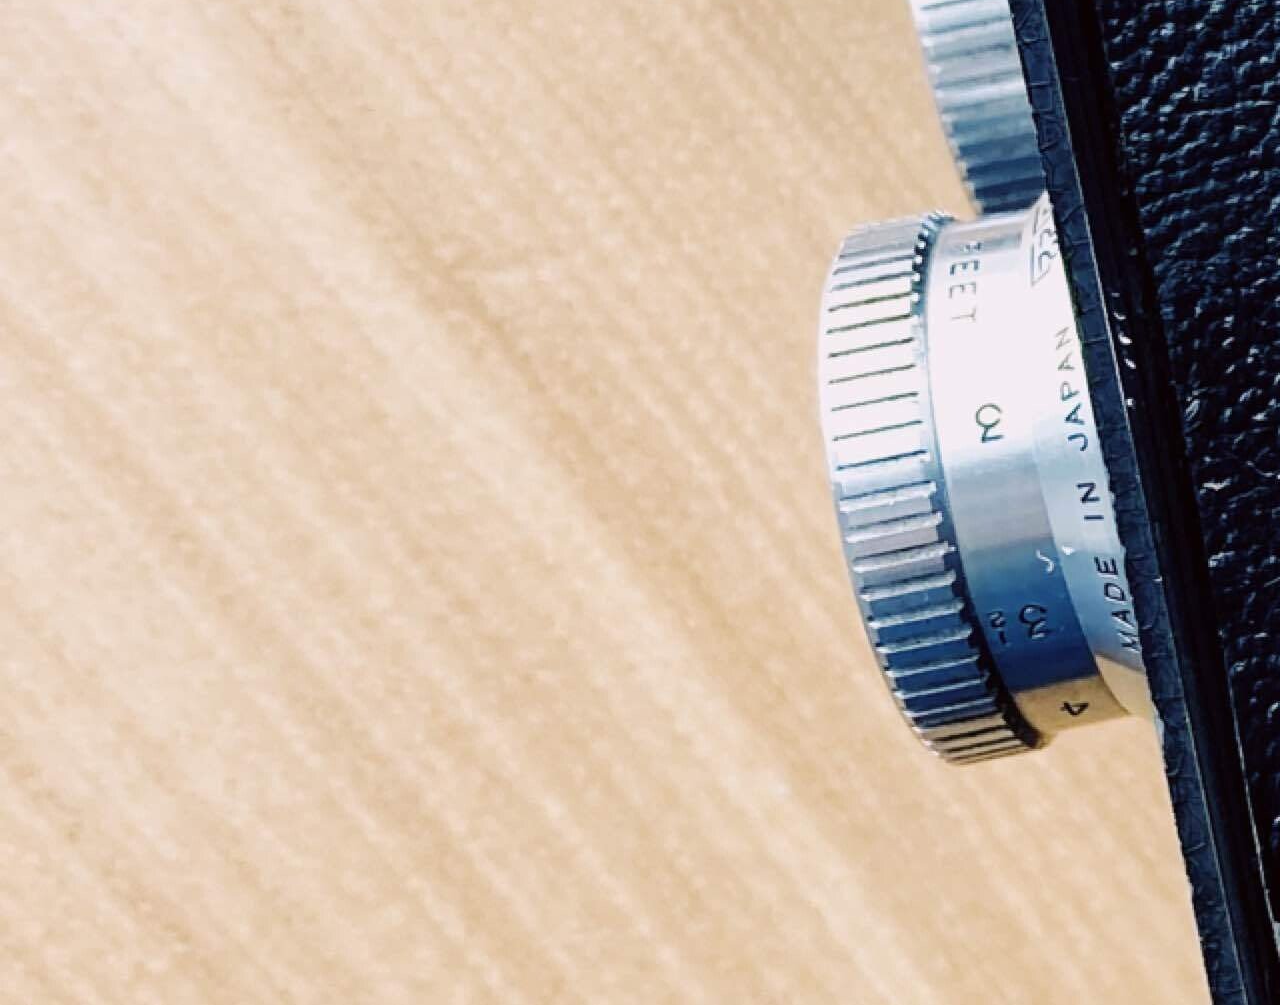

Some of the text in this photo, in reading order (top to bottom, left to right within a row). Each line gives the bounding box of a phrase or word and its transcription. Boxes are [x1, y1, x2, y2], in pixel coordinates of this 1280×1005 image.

[1055, 326, 1142, 654] MADE IN JAPAN
